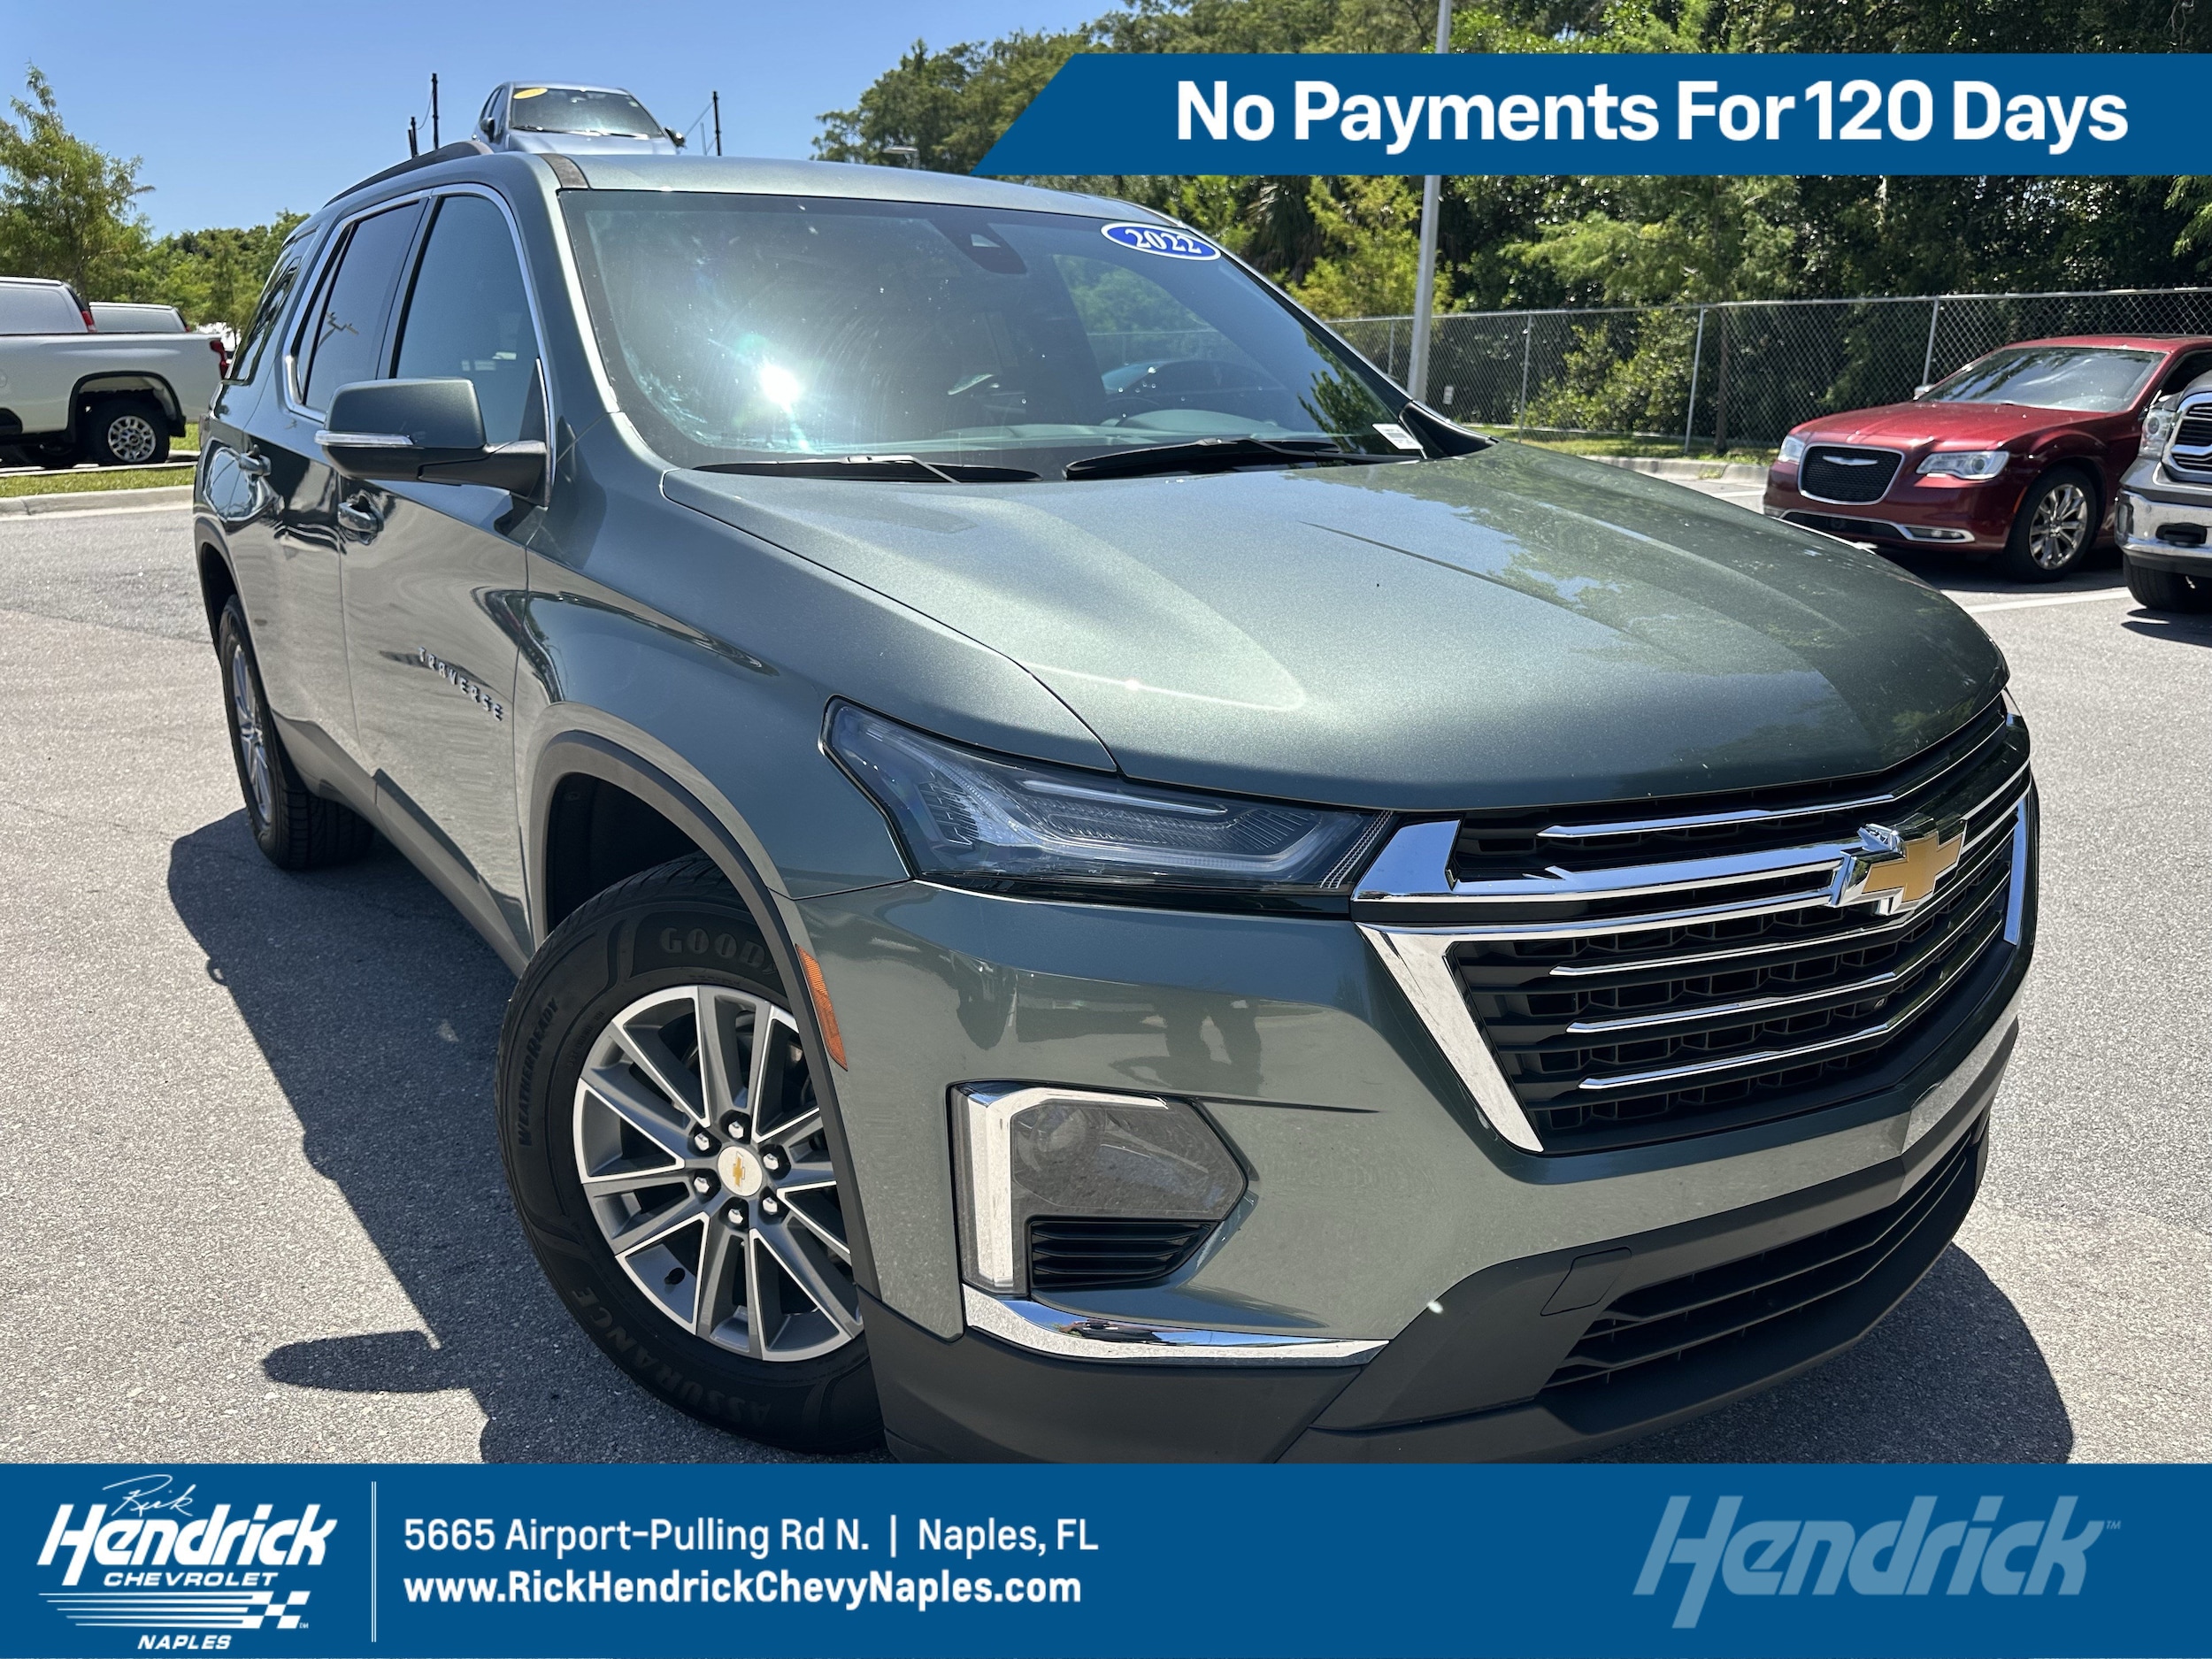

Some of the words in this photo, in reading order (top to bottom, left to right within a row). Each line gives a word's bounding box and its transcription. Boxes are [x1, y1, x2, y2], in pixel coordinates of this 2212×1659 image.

[1124, 228, 1202, 254] 2022
[418, 646, 503, 722] TRAVERSE
[571, 1286, 772, 1427] ASSURANCE
